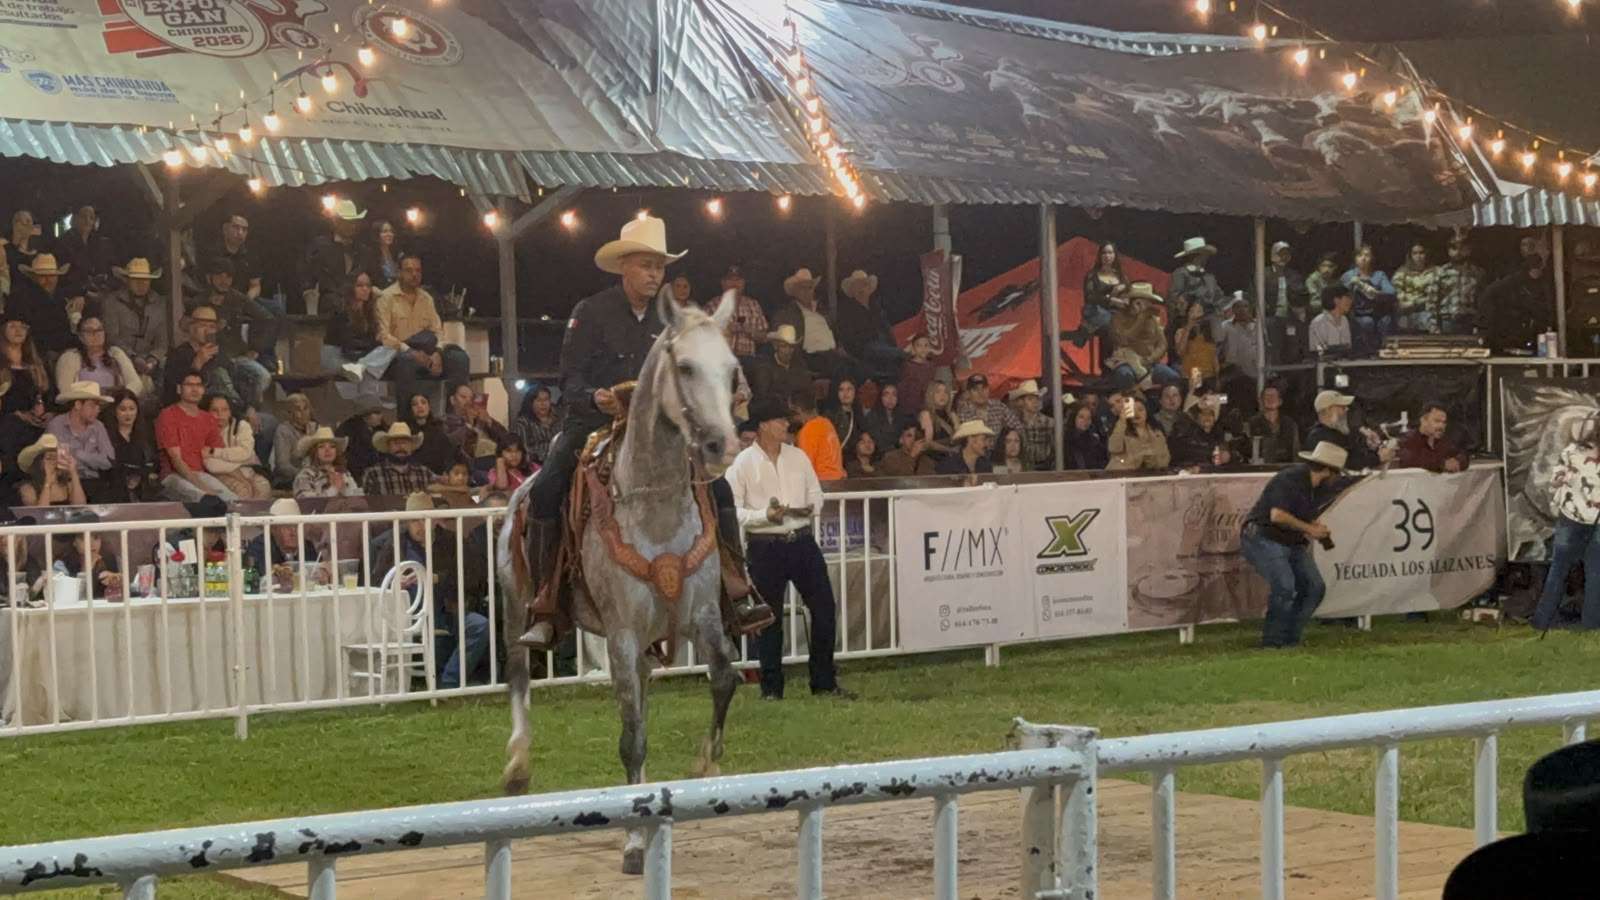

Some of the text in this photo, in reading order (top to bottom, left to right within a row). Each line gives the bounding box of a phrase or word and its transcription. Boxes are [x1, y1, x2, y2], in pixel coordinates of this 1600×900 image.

[143, 0, 217, 14] EXPO
[163, 9, 224, 26] GAN
[167, 25, 249, 37] CHIHUAHUA
[191, 34, 245, 47] 2026
[95, 76, 173, 92] CHIHUAHUA
[326, 100, 448, 121] Chihuahua!
[1334, 554, 1497, 581] YEGUADA LOS ALAZANES
